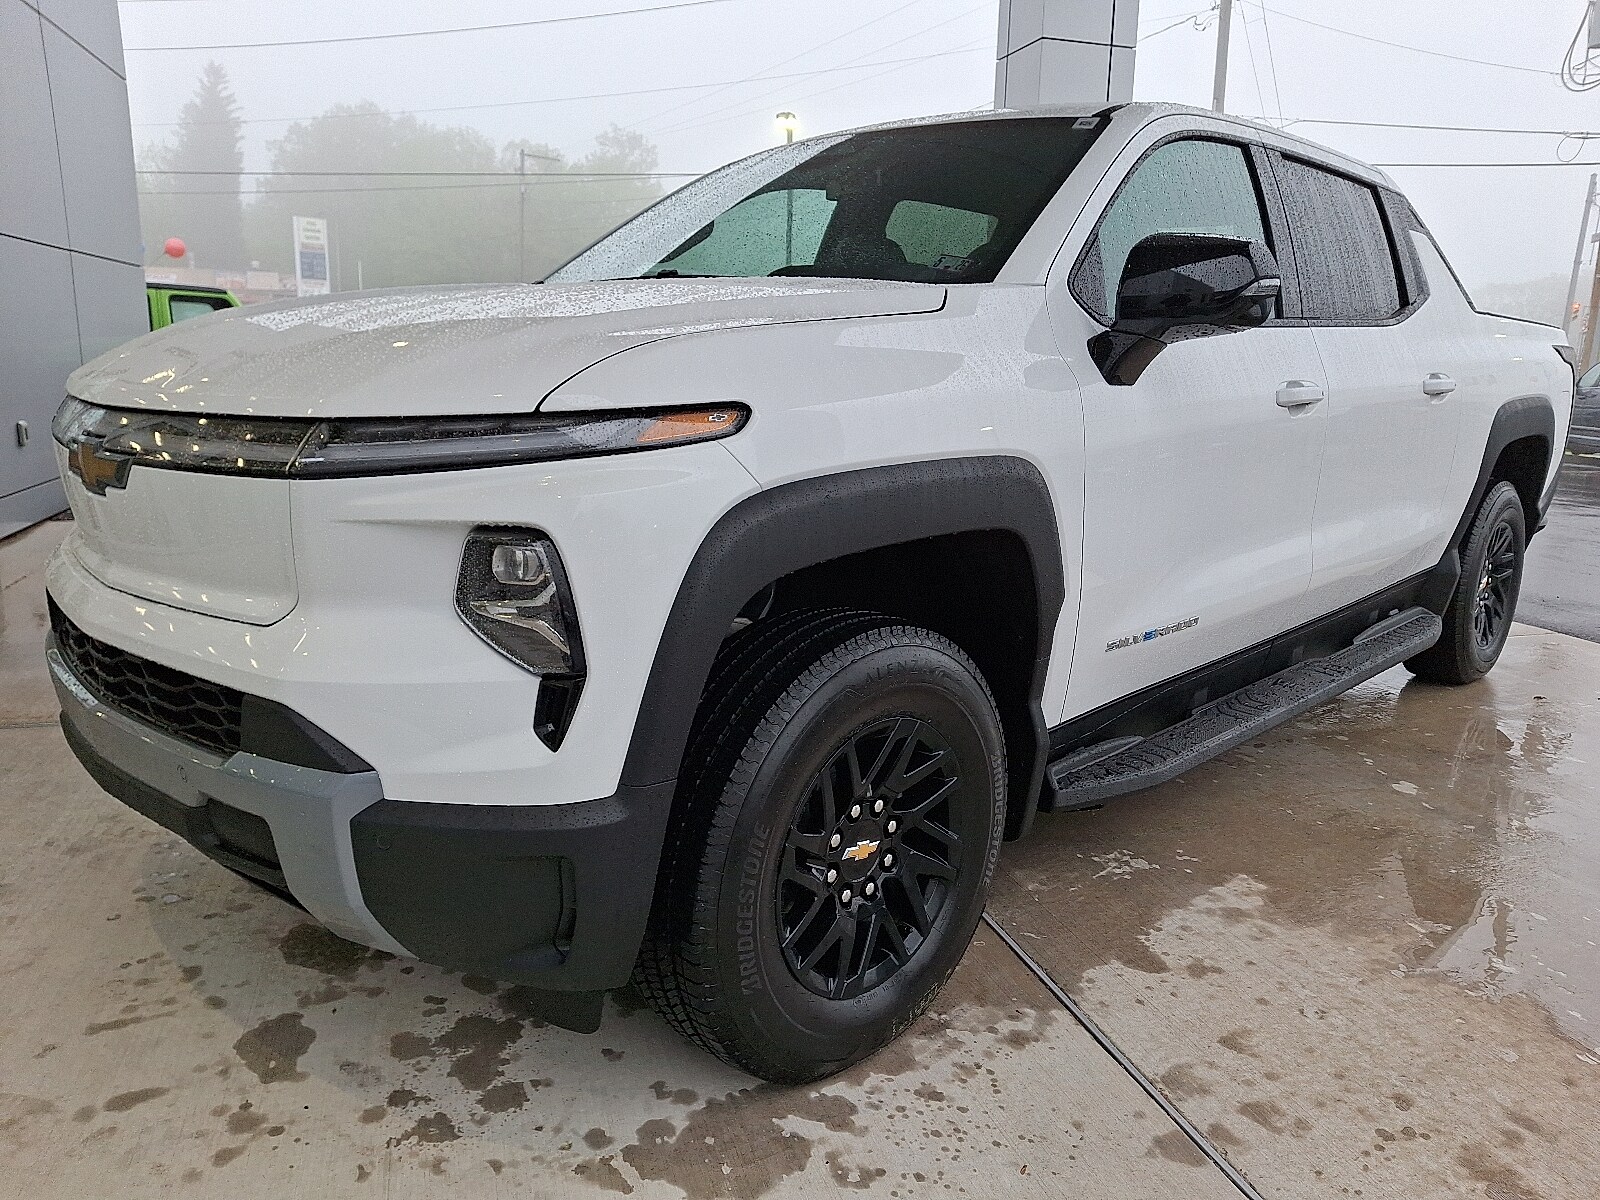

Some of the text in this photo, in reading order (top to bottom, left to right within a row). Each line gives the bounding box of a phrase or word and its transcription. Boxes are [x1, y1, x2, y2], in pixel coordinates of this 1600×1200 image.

[1104, 615, 1200, 652] SILVERADO
[981, 753, 1003, 887] BRIDGESTONE
[736, 820, 771, 996] BRIDGESTONE
